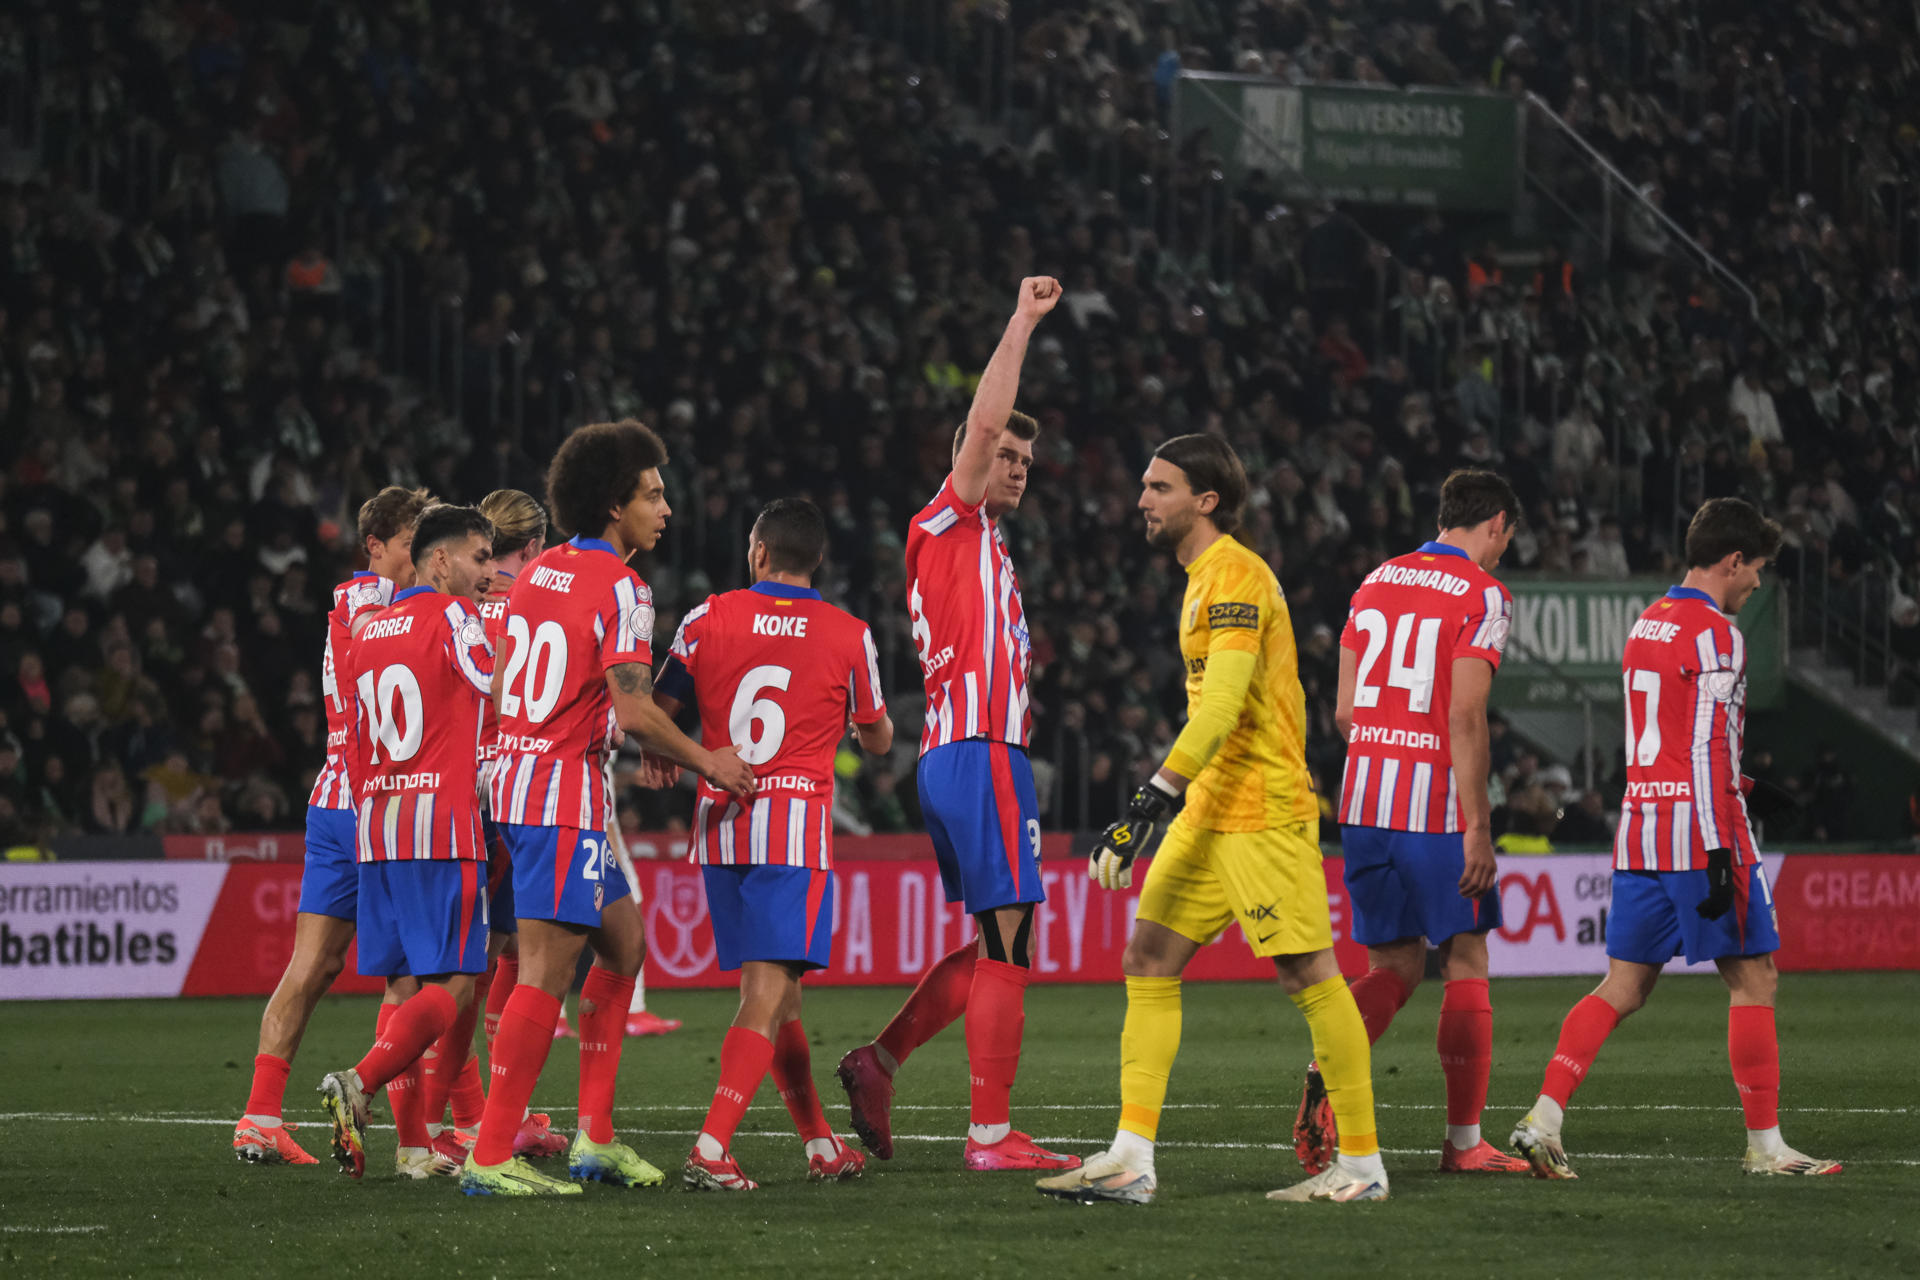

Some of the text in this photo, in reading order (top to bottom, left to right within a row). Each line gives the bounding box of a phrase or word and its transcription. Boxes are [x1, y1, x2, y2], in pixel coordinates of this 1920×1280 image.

[529, 566, 575, 593] WITSEL
[1379, 565, 1470, 596] NORMAND
[362, 616, 414, 641] CORREA
[752, 614, 808, 637] KOKE
[501, 615, 568, 723] 20
[1354, 608, 1442, 714] 24
[356, 663, 424, 765] 10
[729, 664, 792, 765] 6
[1361, 726, 1440, 750] HYUNDAI
[1026, 818, 1041, 859] 9
[0, 921, 177, 967] batibles
